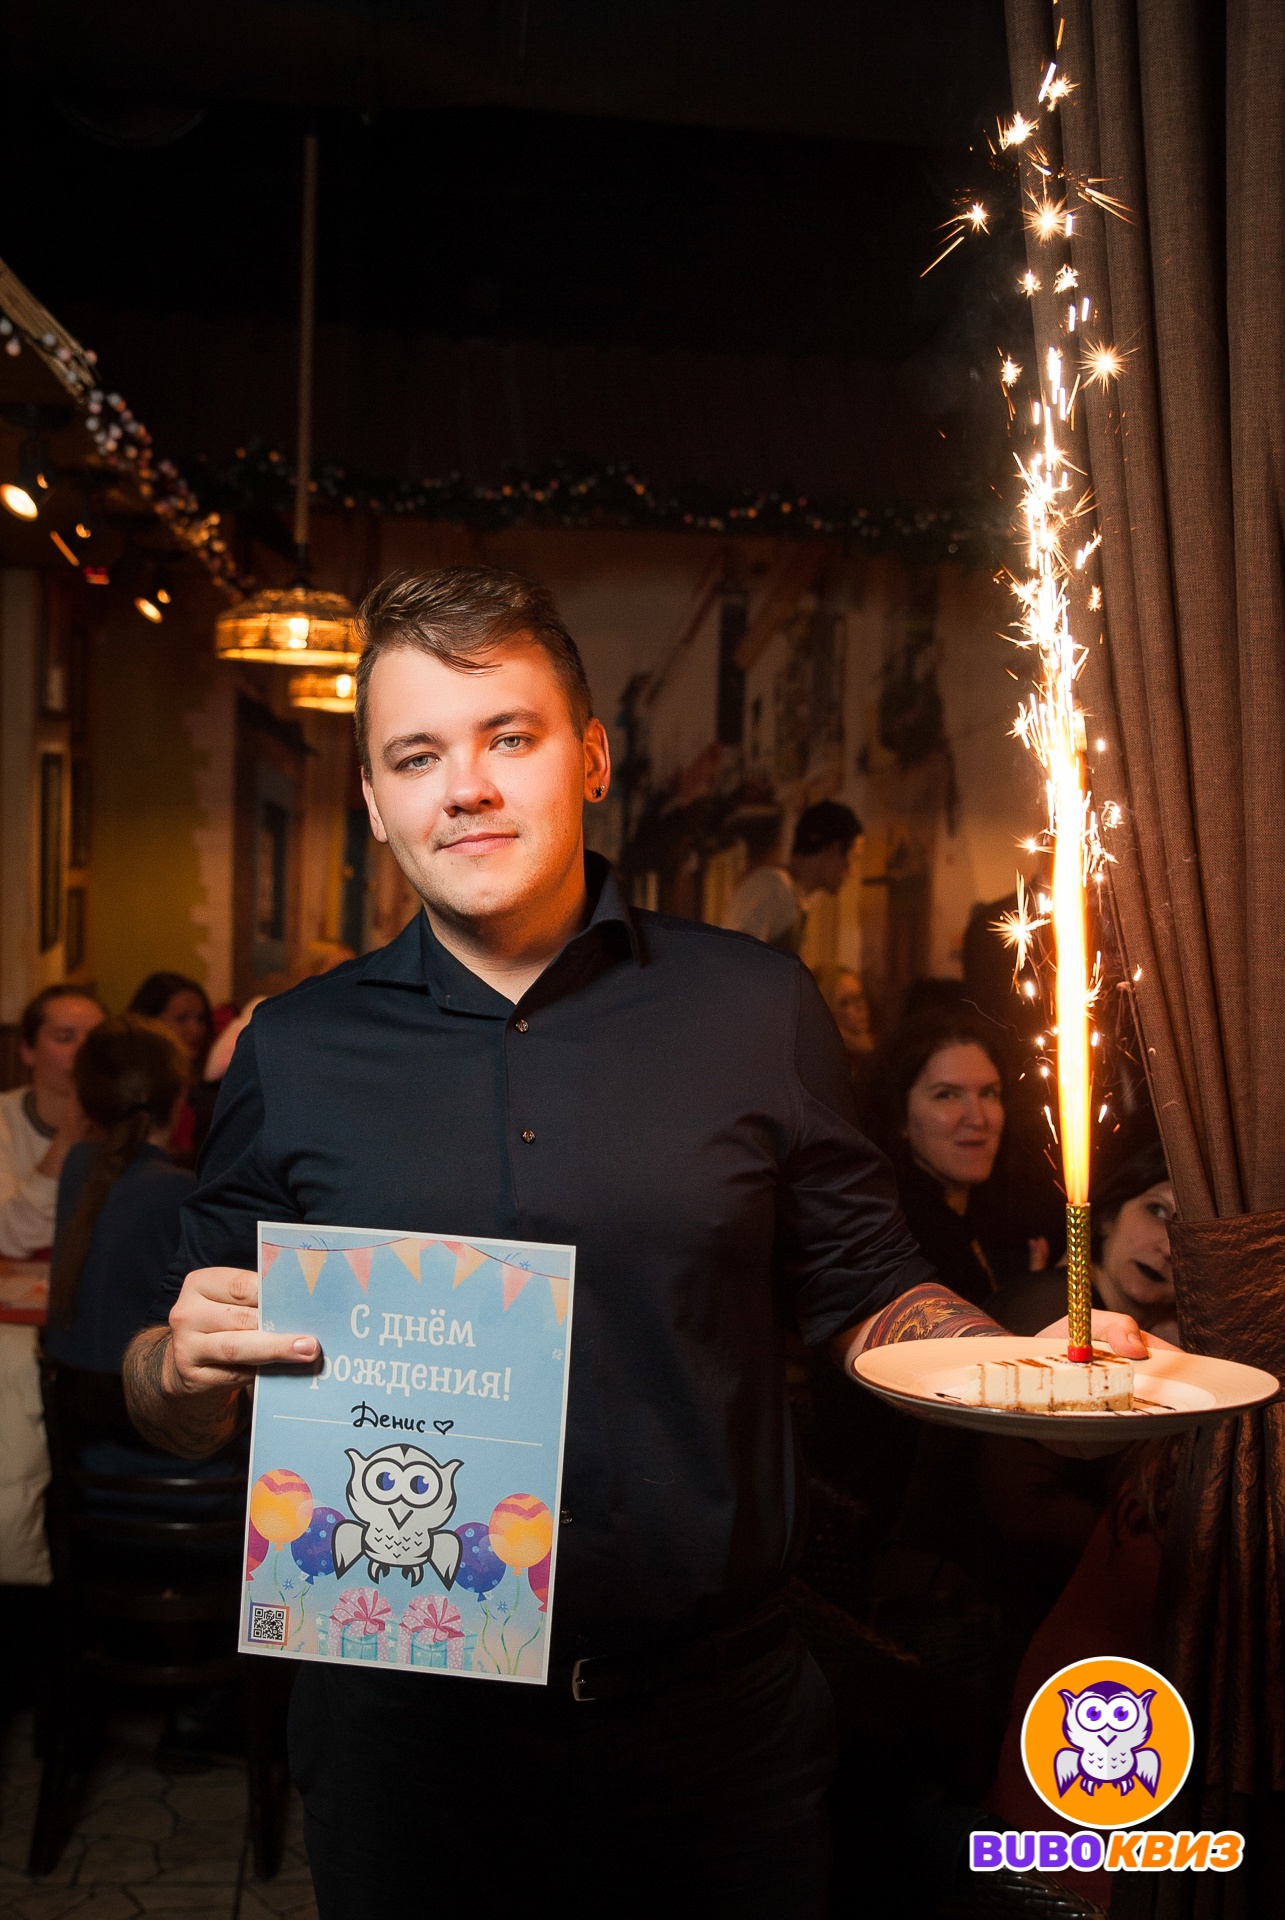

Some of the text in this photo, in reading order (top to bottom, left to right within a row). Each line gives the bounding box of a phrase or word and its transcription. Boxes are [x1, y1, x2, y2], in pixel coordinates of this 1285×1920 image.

[350, 1303, 477, 1348] С днём
[309, 1354, 512, 1402] рождения!
[350, 1400, 426, 1433] Денис
